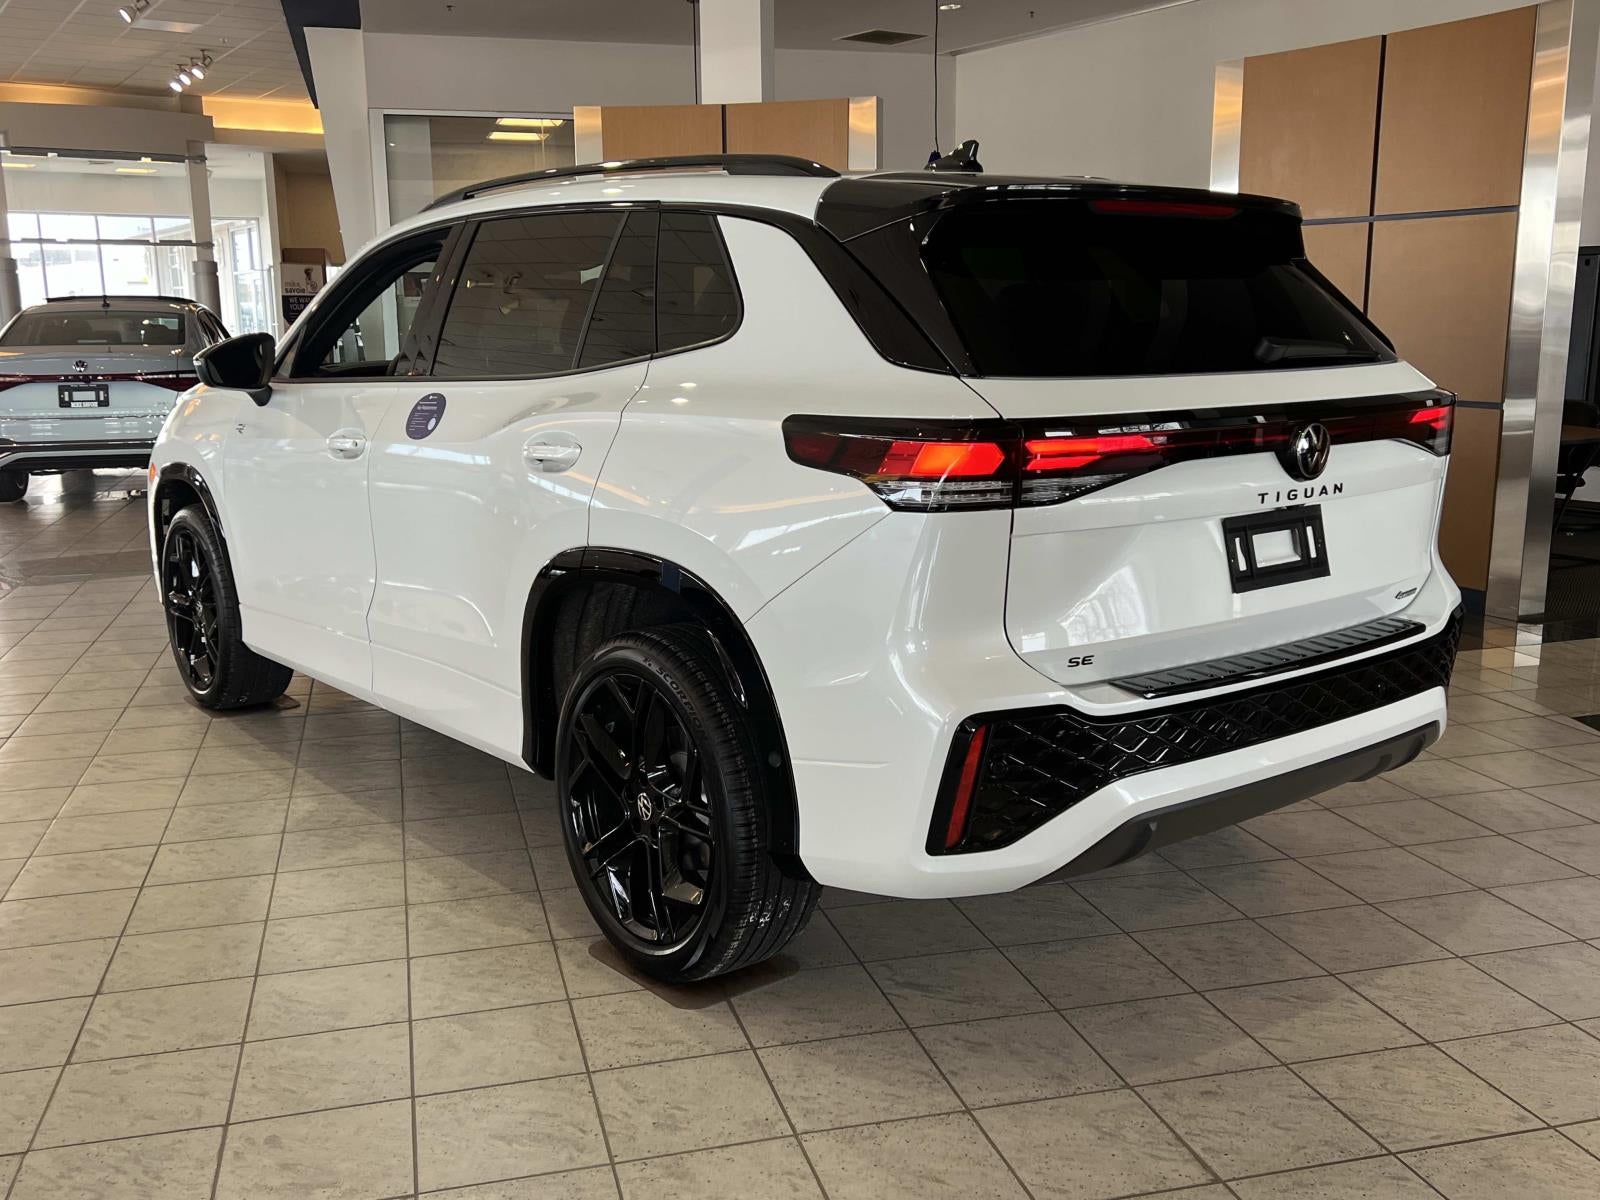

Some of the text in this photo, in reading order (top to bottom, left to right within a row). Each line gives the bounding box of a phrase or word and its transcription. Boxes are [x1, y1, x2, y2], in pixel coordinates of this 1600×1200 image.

[289, 296, 299, 304] WE
[1257, 482, 1344, 505] TIGUAN
[1067, 654, 1095, 668] SE
